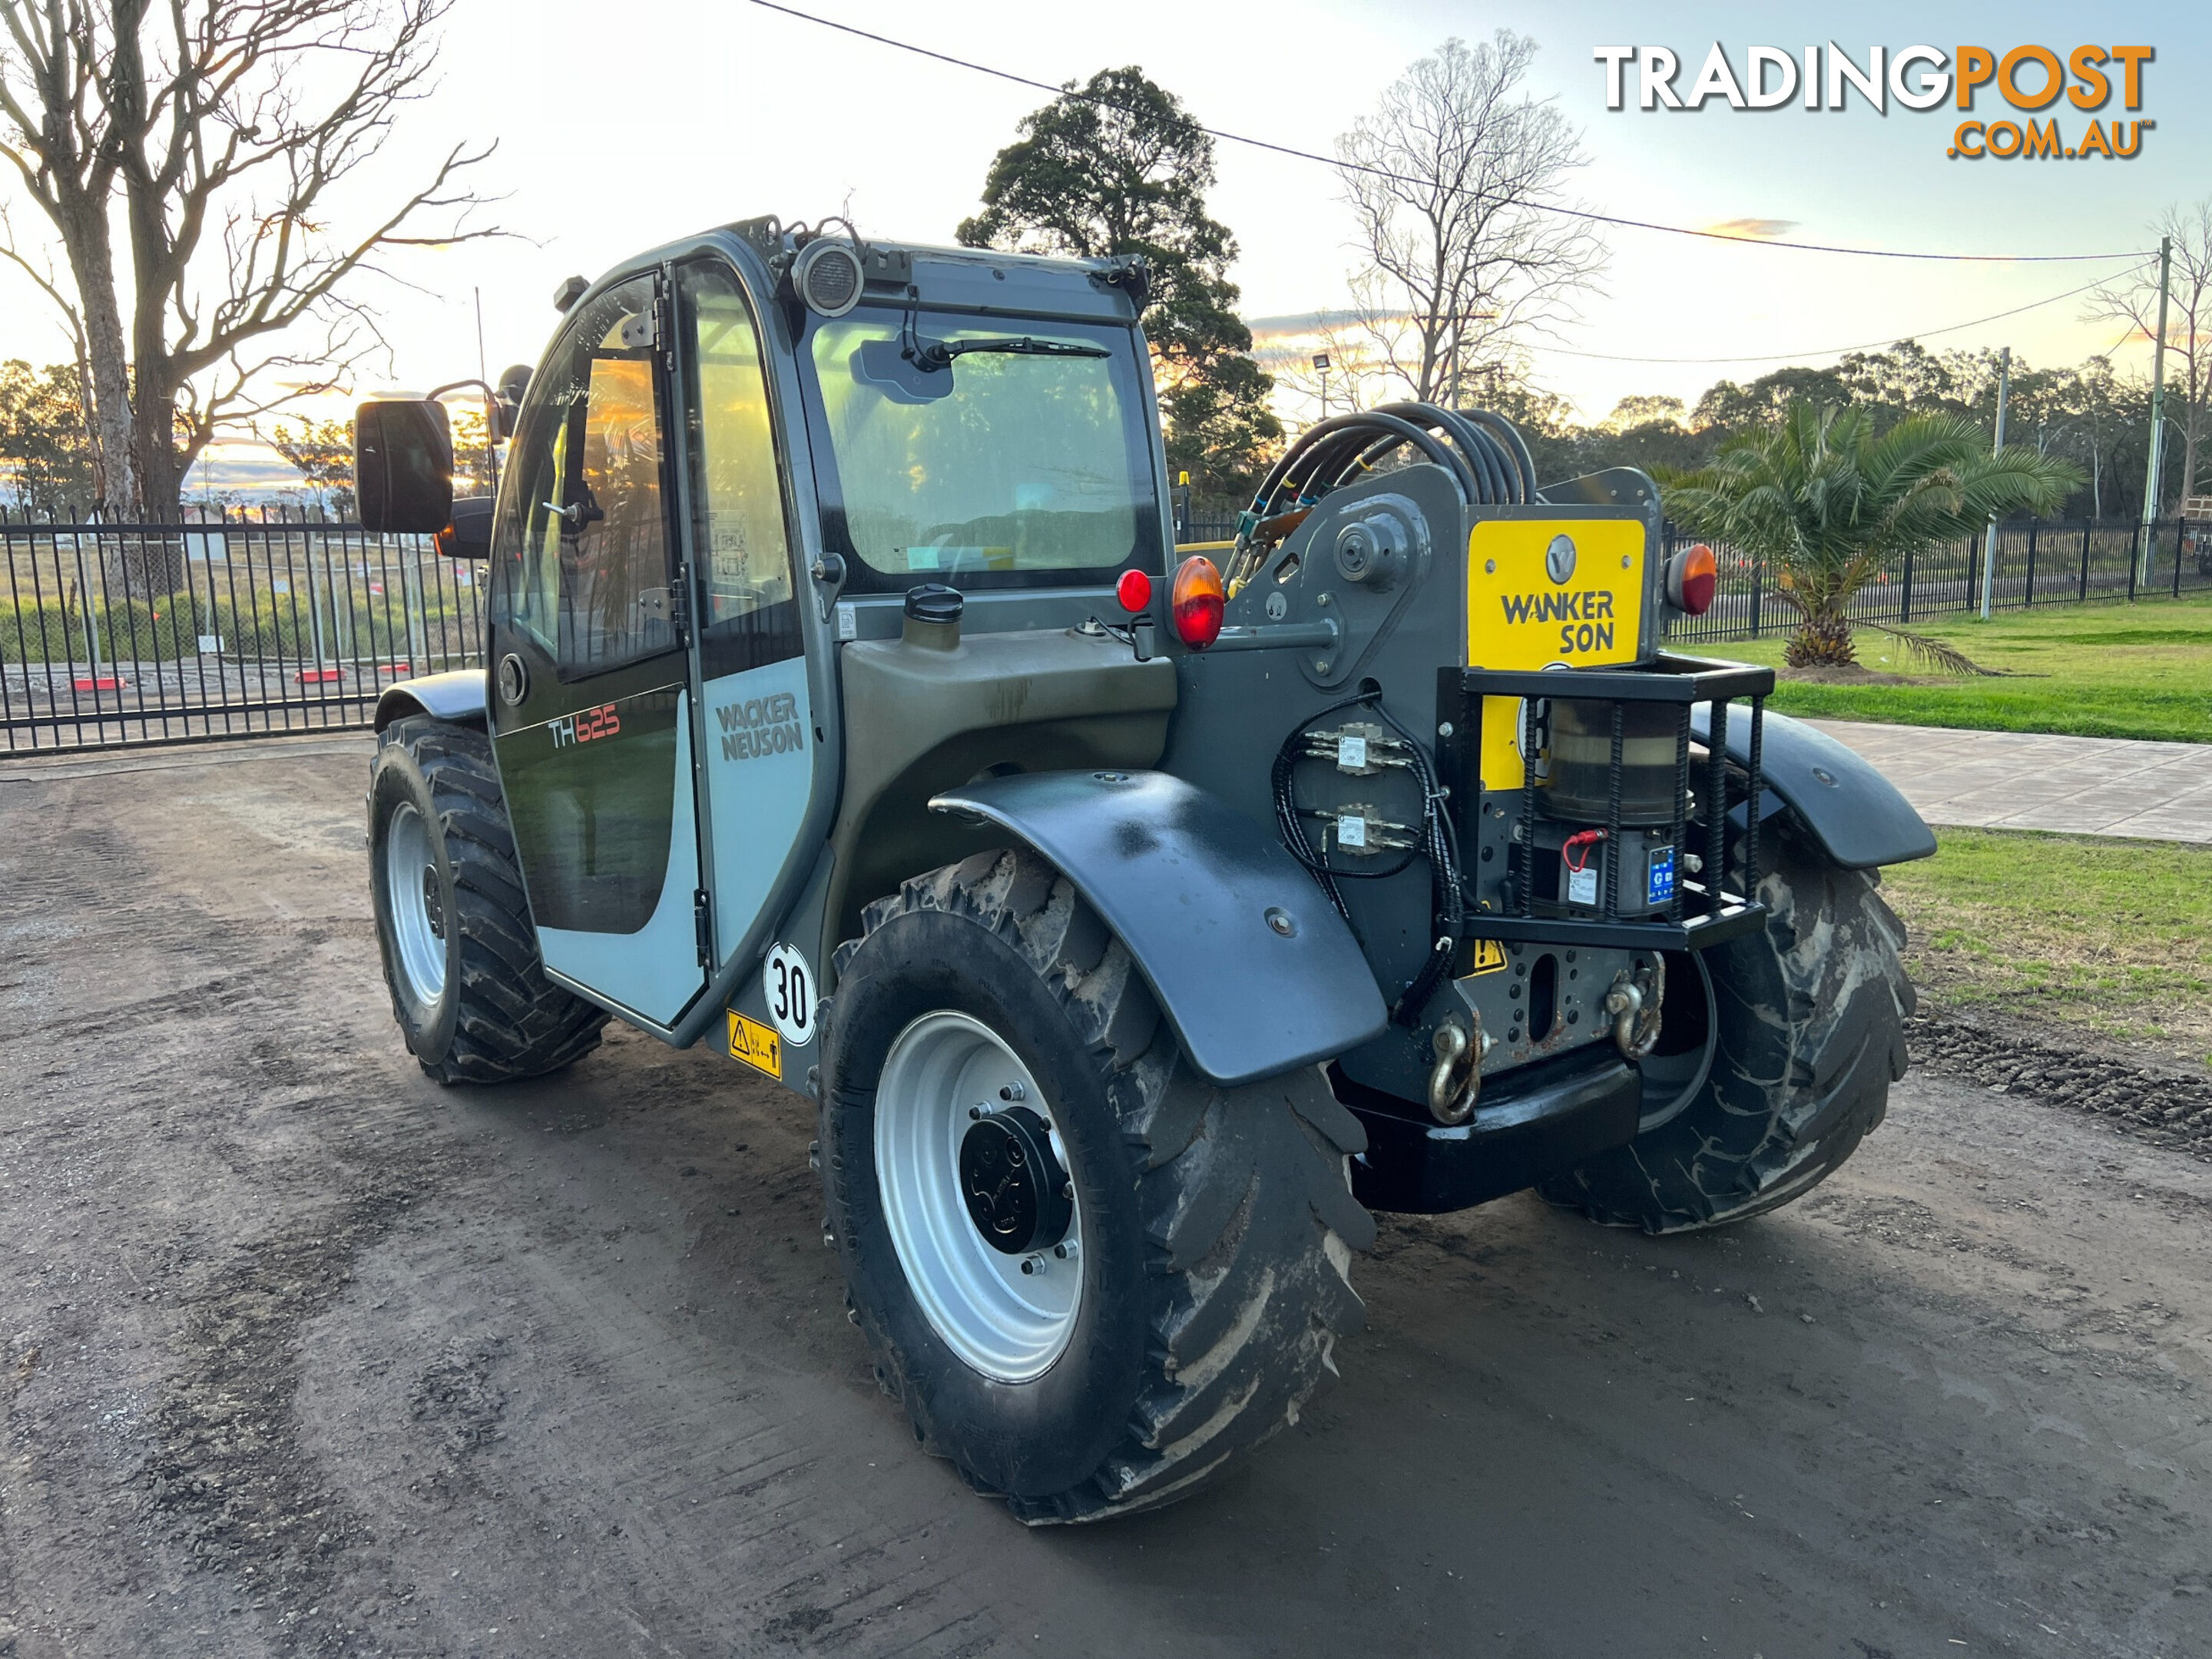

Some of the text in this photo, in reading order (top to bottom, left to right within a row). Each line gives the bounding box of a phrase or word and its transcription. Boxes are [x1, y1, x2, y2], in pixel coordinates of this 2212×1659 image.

[1500, 591, 1614, 624] WANKER
[1559, 622, 1614, 654] SON
[548, 704, 620, 748] TH625
[715, 692, 799, 733] WACKER
[721, 722, 803, 762] NEUSON
[773, 958, 806, 1029] 30
